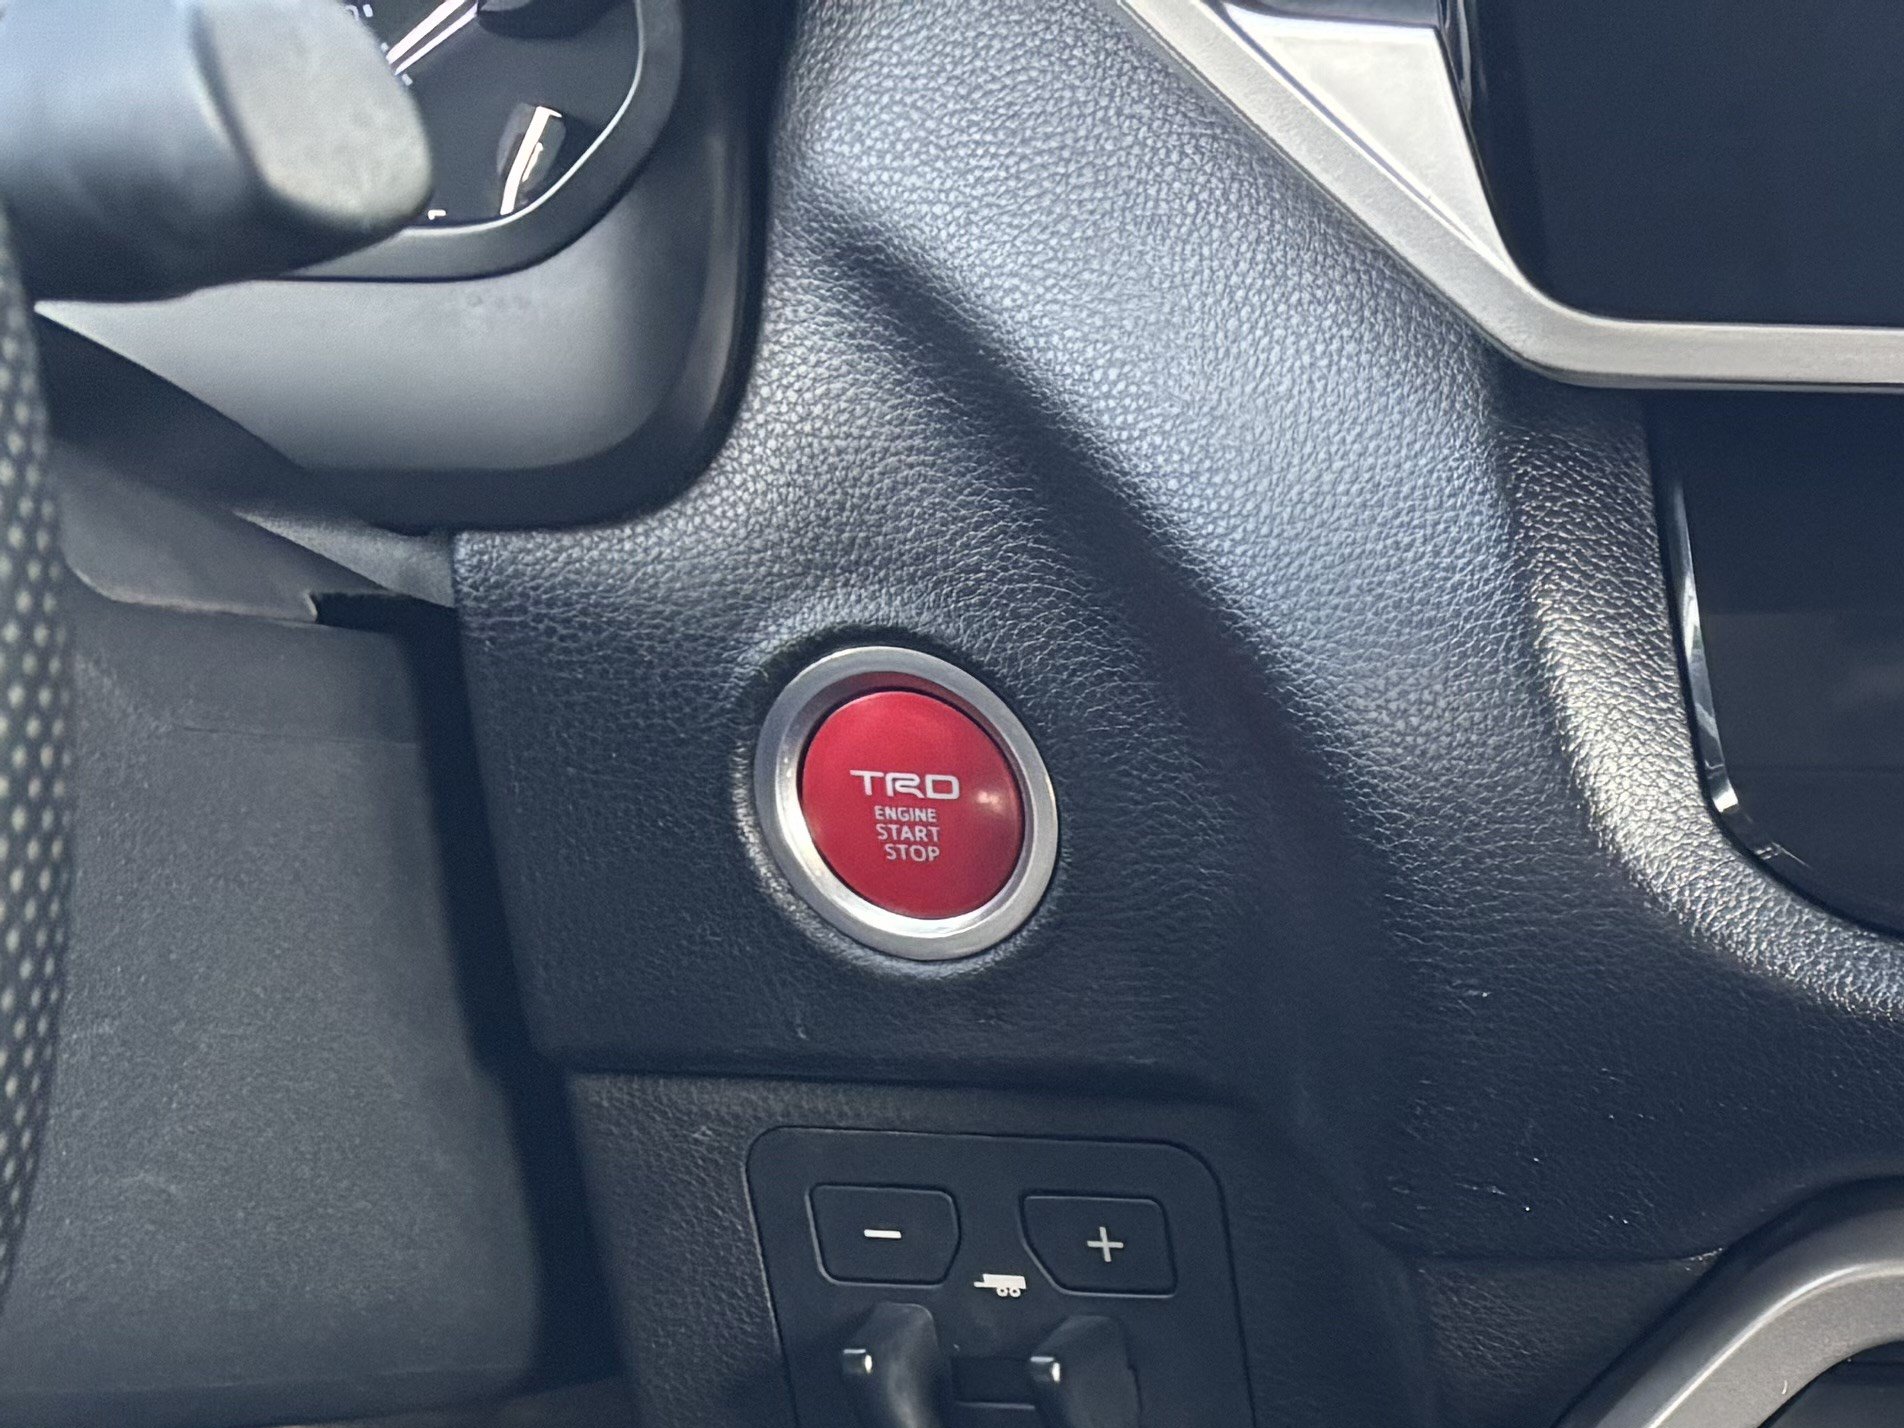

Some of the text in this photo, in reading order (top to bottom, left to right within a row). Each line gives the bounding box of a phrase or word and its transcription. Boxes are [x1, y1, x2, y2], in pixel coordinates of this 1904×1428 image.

[850, 769, 960, 800] TRD
[874, 805, 937, 823] ENGINE
[875, 823, 940, 842] START
[884, 843, 940, 862] STOP
